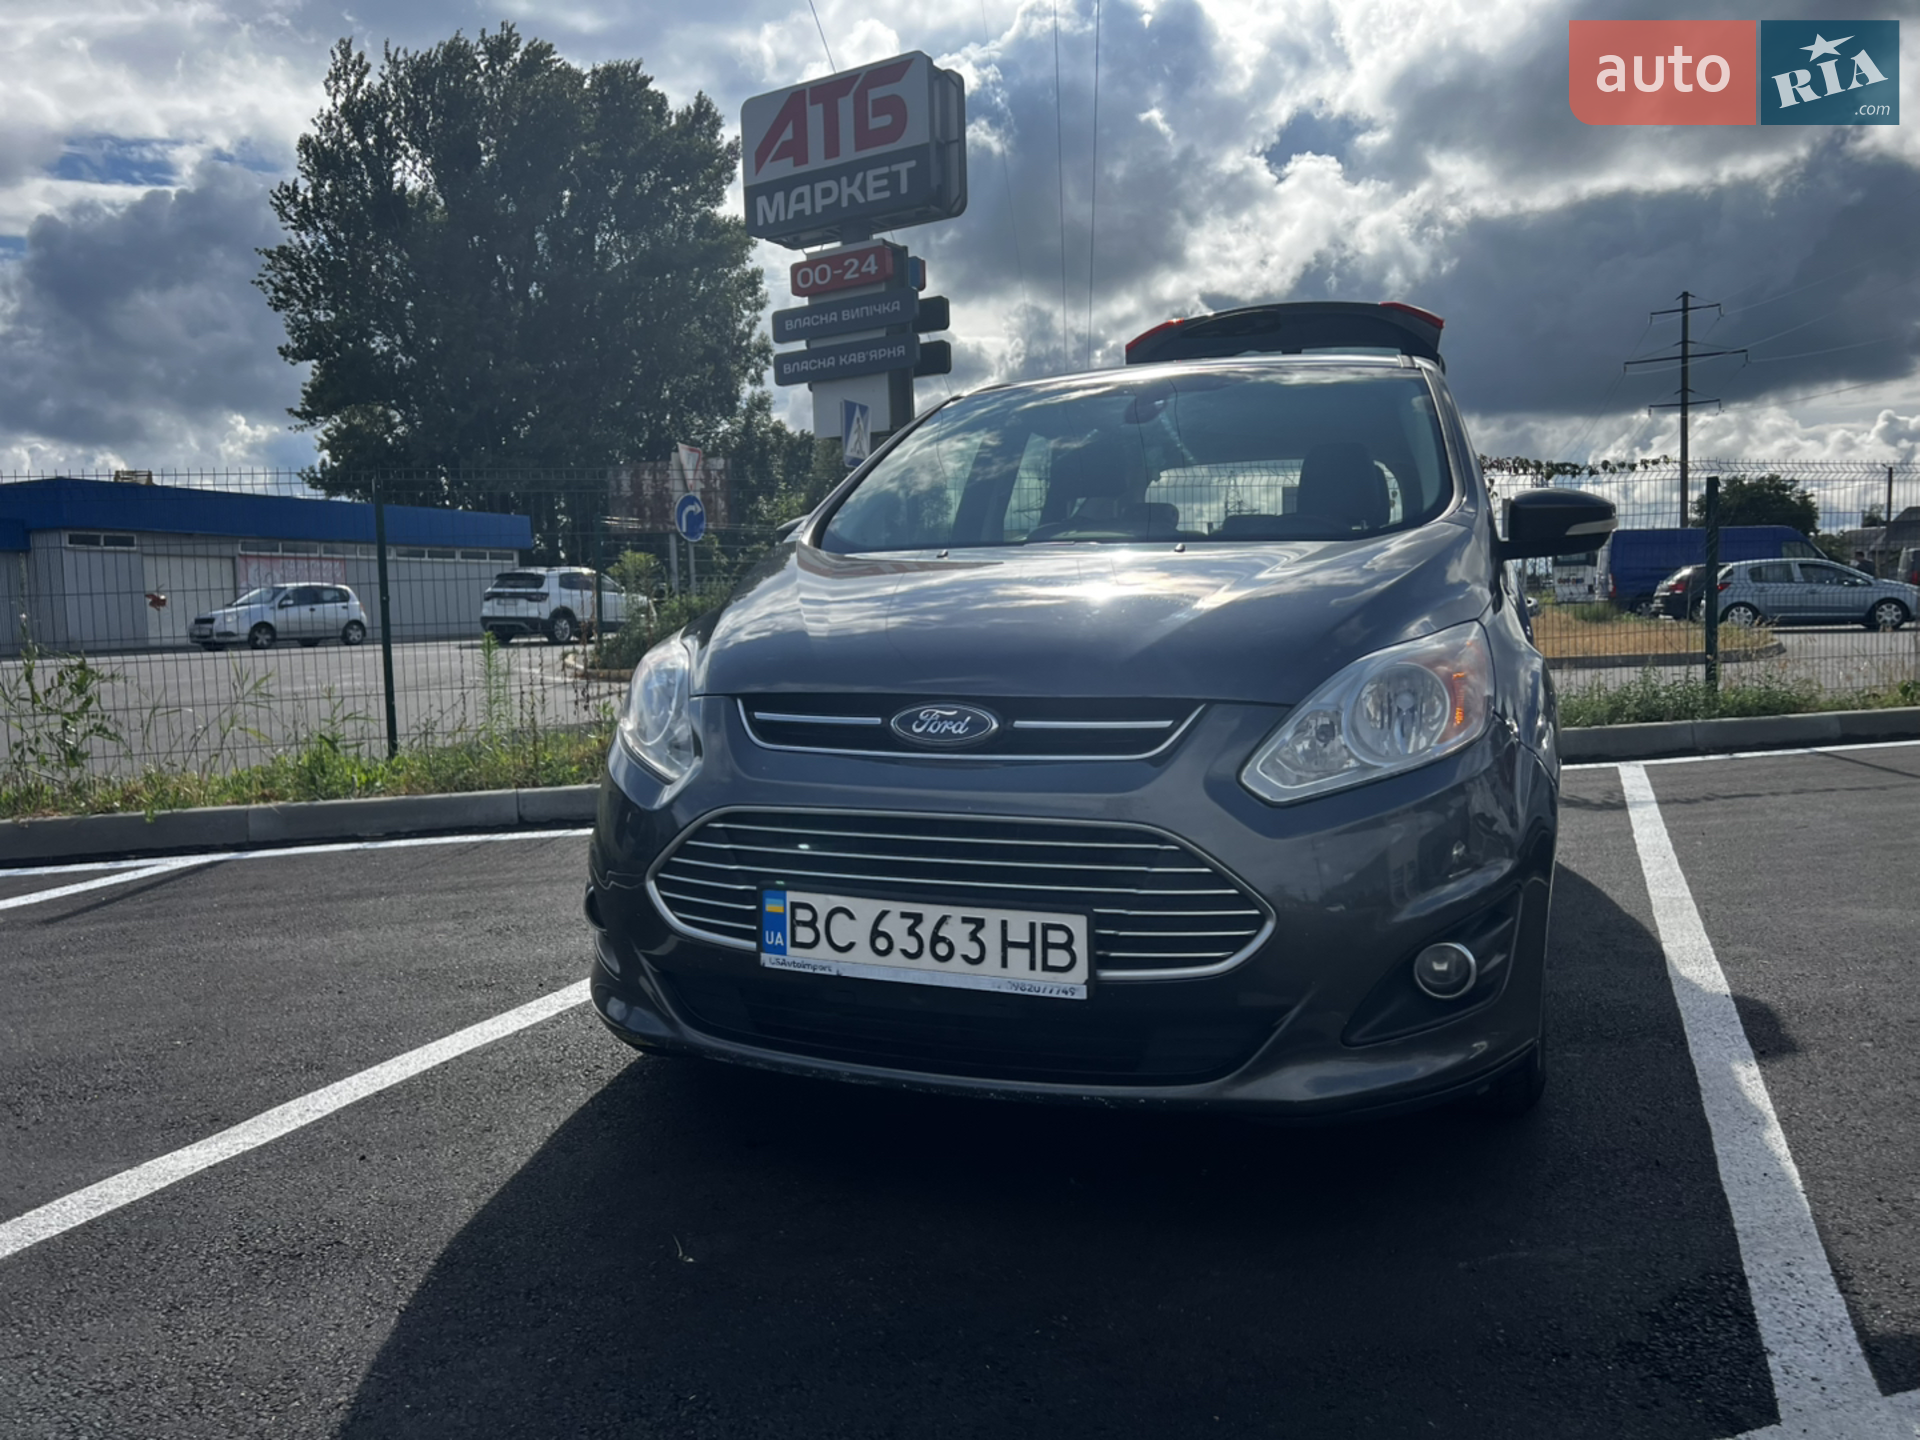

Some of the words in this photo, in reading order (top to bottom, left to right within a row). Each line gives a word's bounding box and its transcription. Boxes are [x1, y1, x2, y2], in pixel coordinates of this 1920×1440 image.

[754, 57, 915, 178] АТБ
[756, 159, 917, 227] МАРКЕТ
[796, 253, 878, 289] 00-24
[785, 311, 838, 331] ВЛАСНА
[842, 300, 900, 321] ВИПІЧКА
[783, 355, 836, 375] ВЛАСНА
[912, 708, 971, 734] Ford
[765, 930, 784, 947] UA
[790, 901, 857, 953] BC
[869, 909, 987, 966] 6363
[1000, 918, 1078, 974] HB
